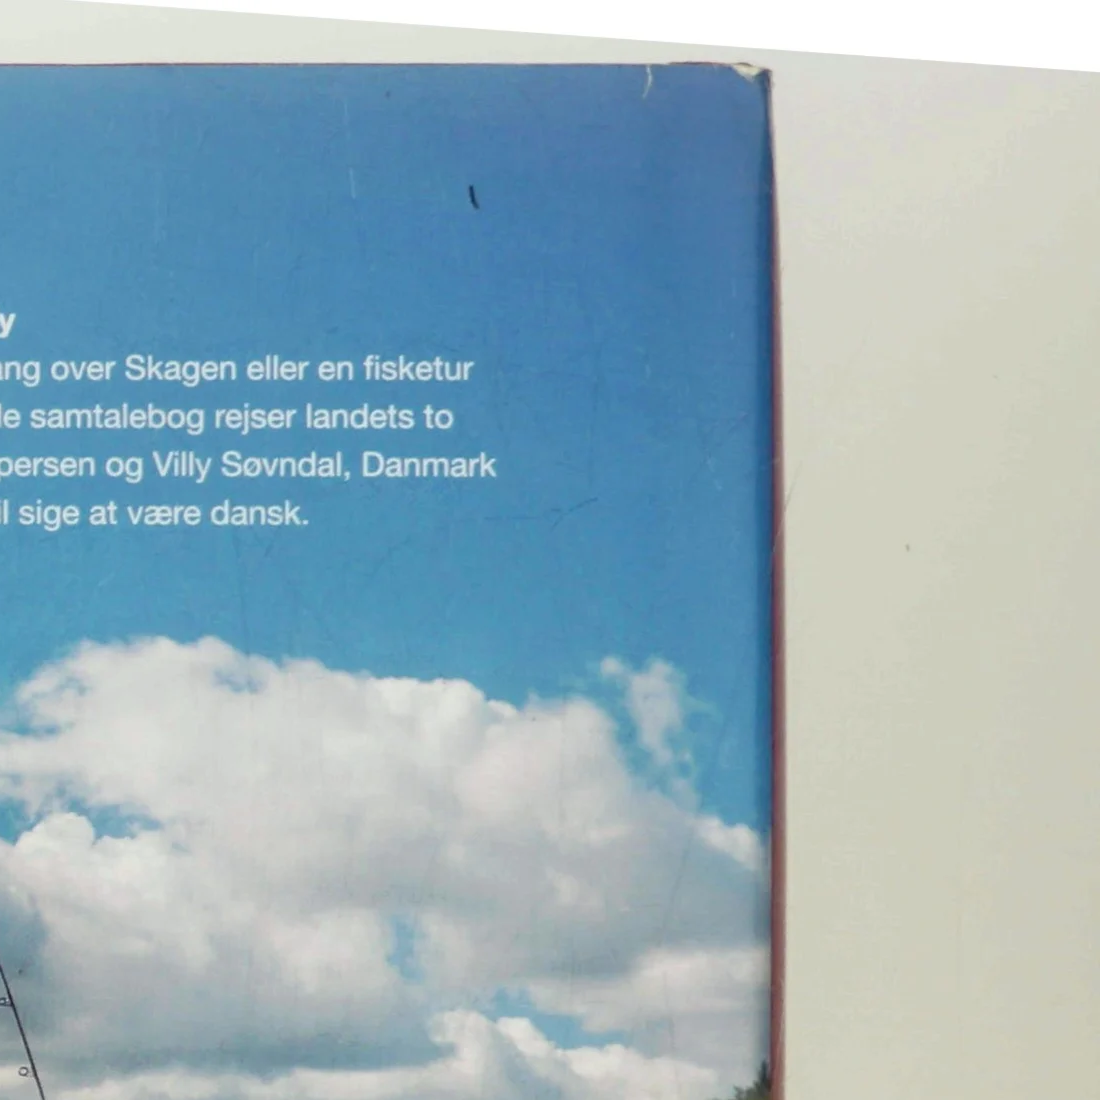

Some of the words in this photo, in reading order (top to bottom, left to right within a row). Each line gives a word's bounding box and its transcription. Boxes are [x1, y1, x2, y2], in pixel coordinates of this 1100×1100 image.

[50, 360, 117, 382] over
[124, 353, 237, 388] Skagen
[246, 354, 310, 381] eller
[317, 360, 354, 382] en
[362, 354, 475, 382] fisketur
[30, 402, 205, 436] samtalebog
[215, 403, 297, 436] rejser
[305, 402, 416, 430] landets
[422, 404, 454, 430] to
[104, 456, 144, 484] og
[152, 450, 212, 484] Villy
[220, 450, 351, 481] Søvndal,
[361, 450, 497, 478] Danmark
[18, 499, 81, 532] sige
[88, 500, 118, 526] at
[126, 505, 202, 526] være
[209, 499, 309, 526] dansk.
